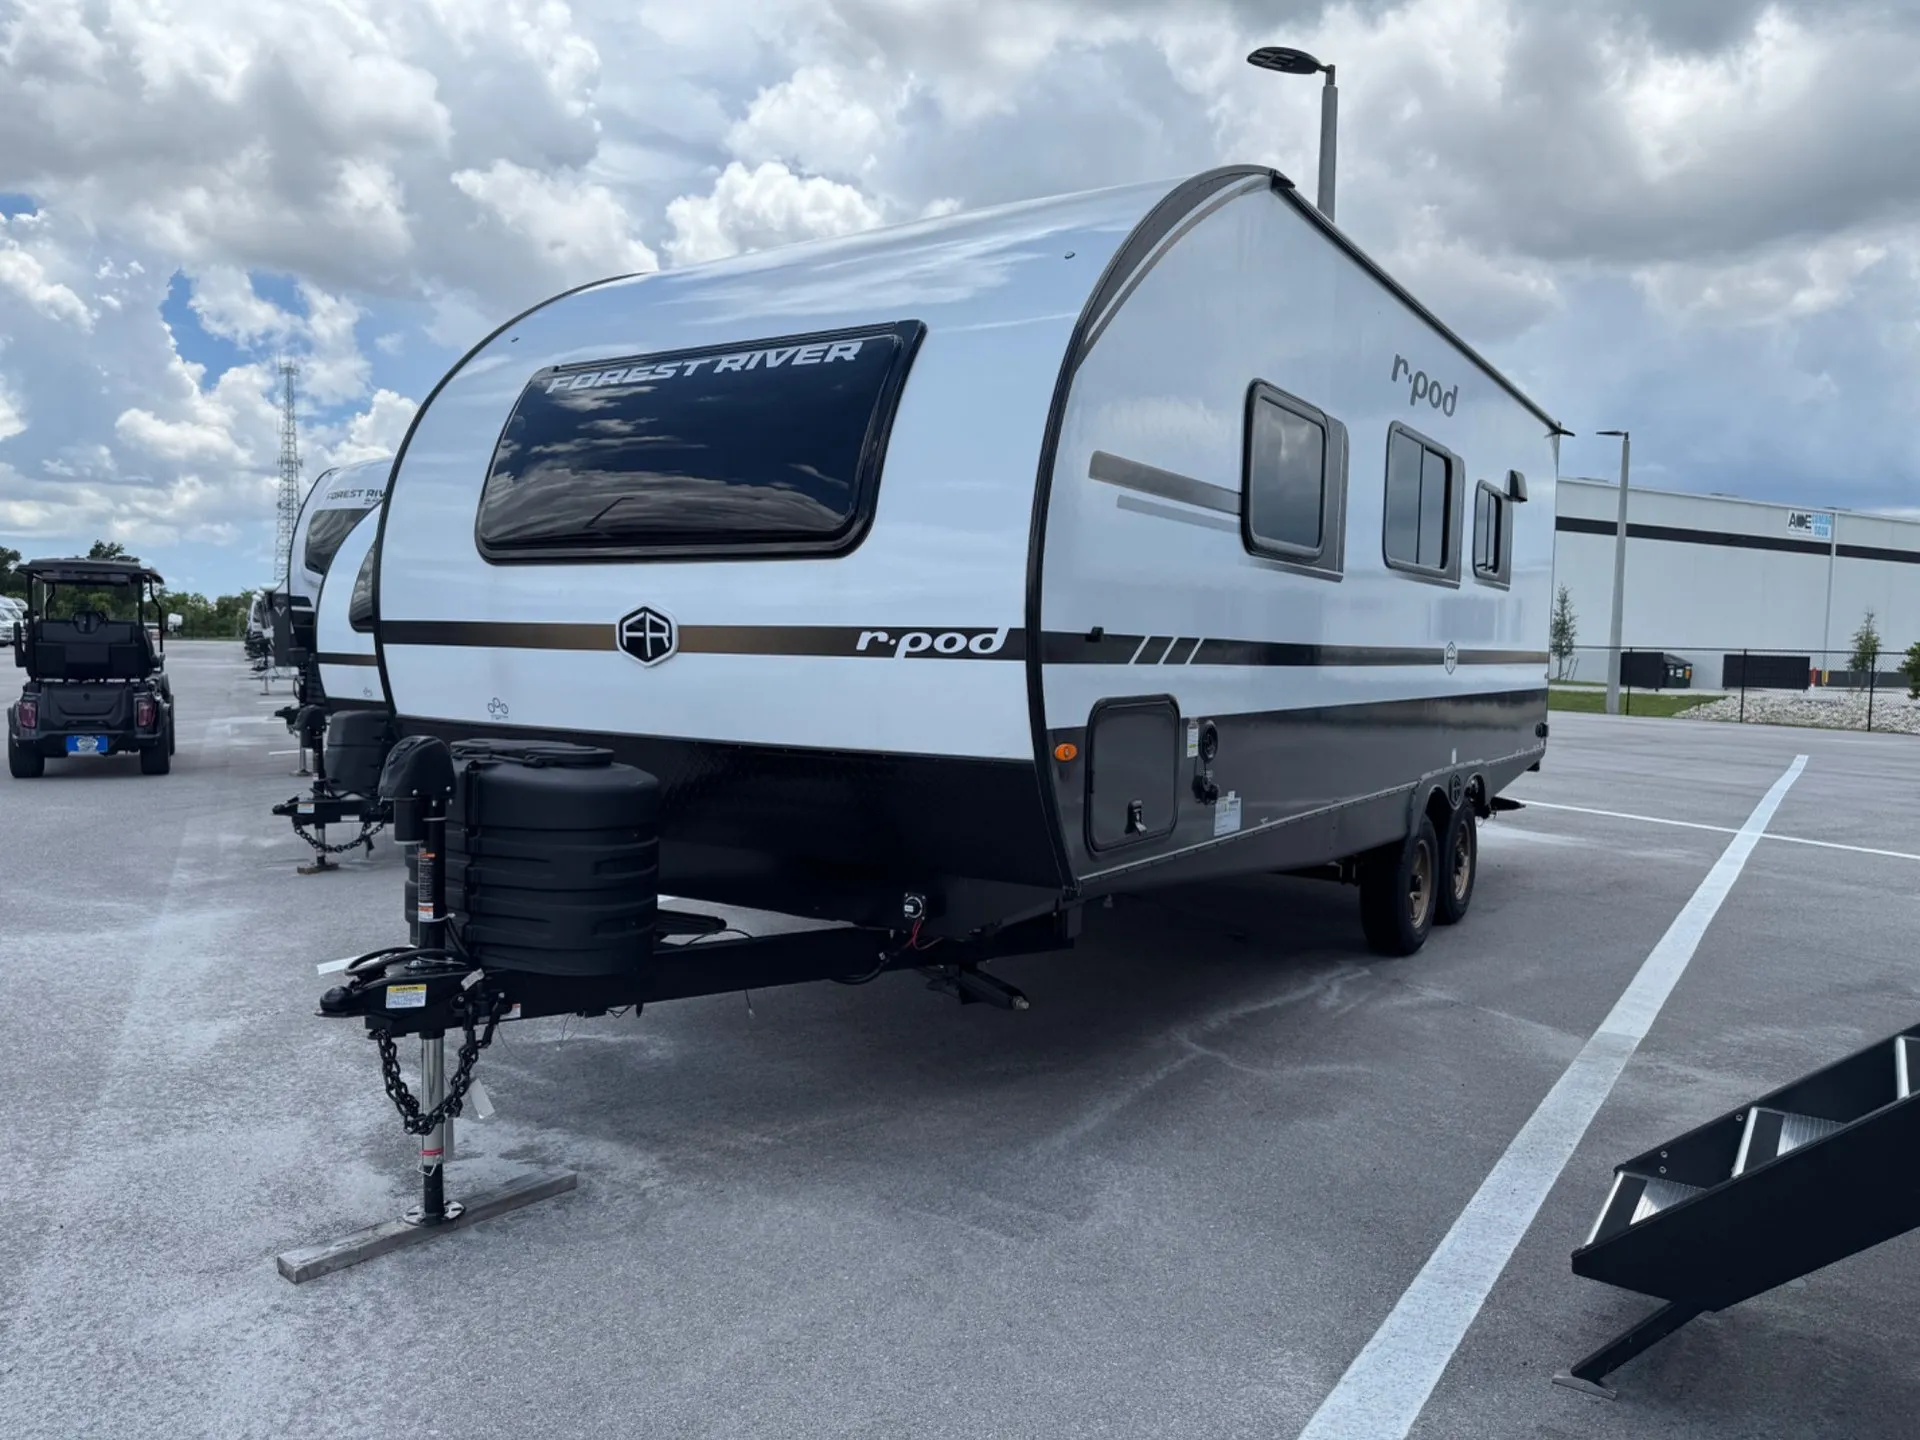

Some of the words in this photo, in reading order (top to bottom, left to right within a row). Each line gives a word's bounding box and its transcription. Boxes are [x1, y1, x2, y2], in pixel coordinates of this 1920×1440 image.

[545, 358, 714, 394] FOREST
[713, 341, 863, 374] RIVER
[327, 490, 364, 499] FOREST
